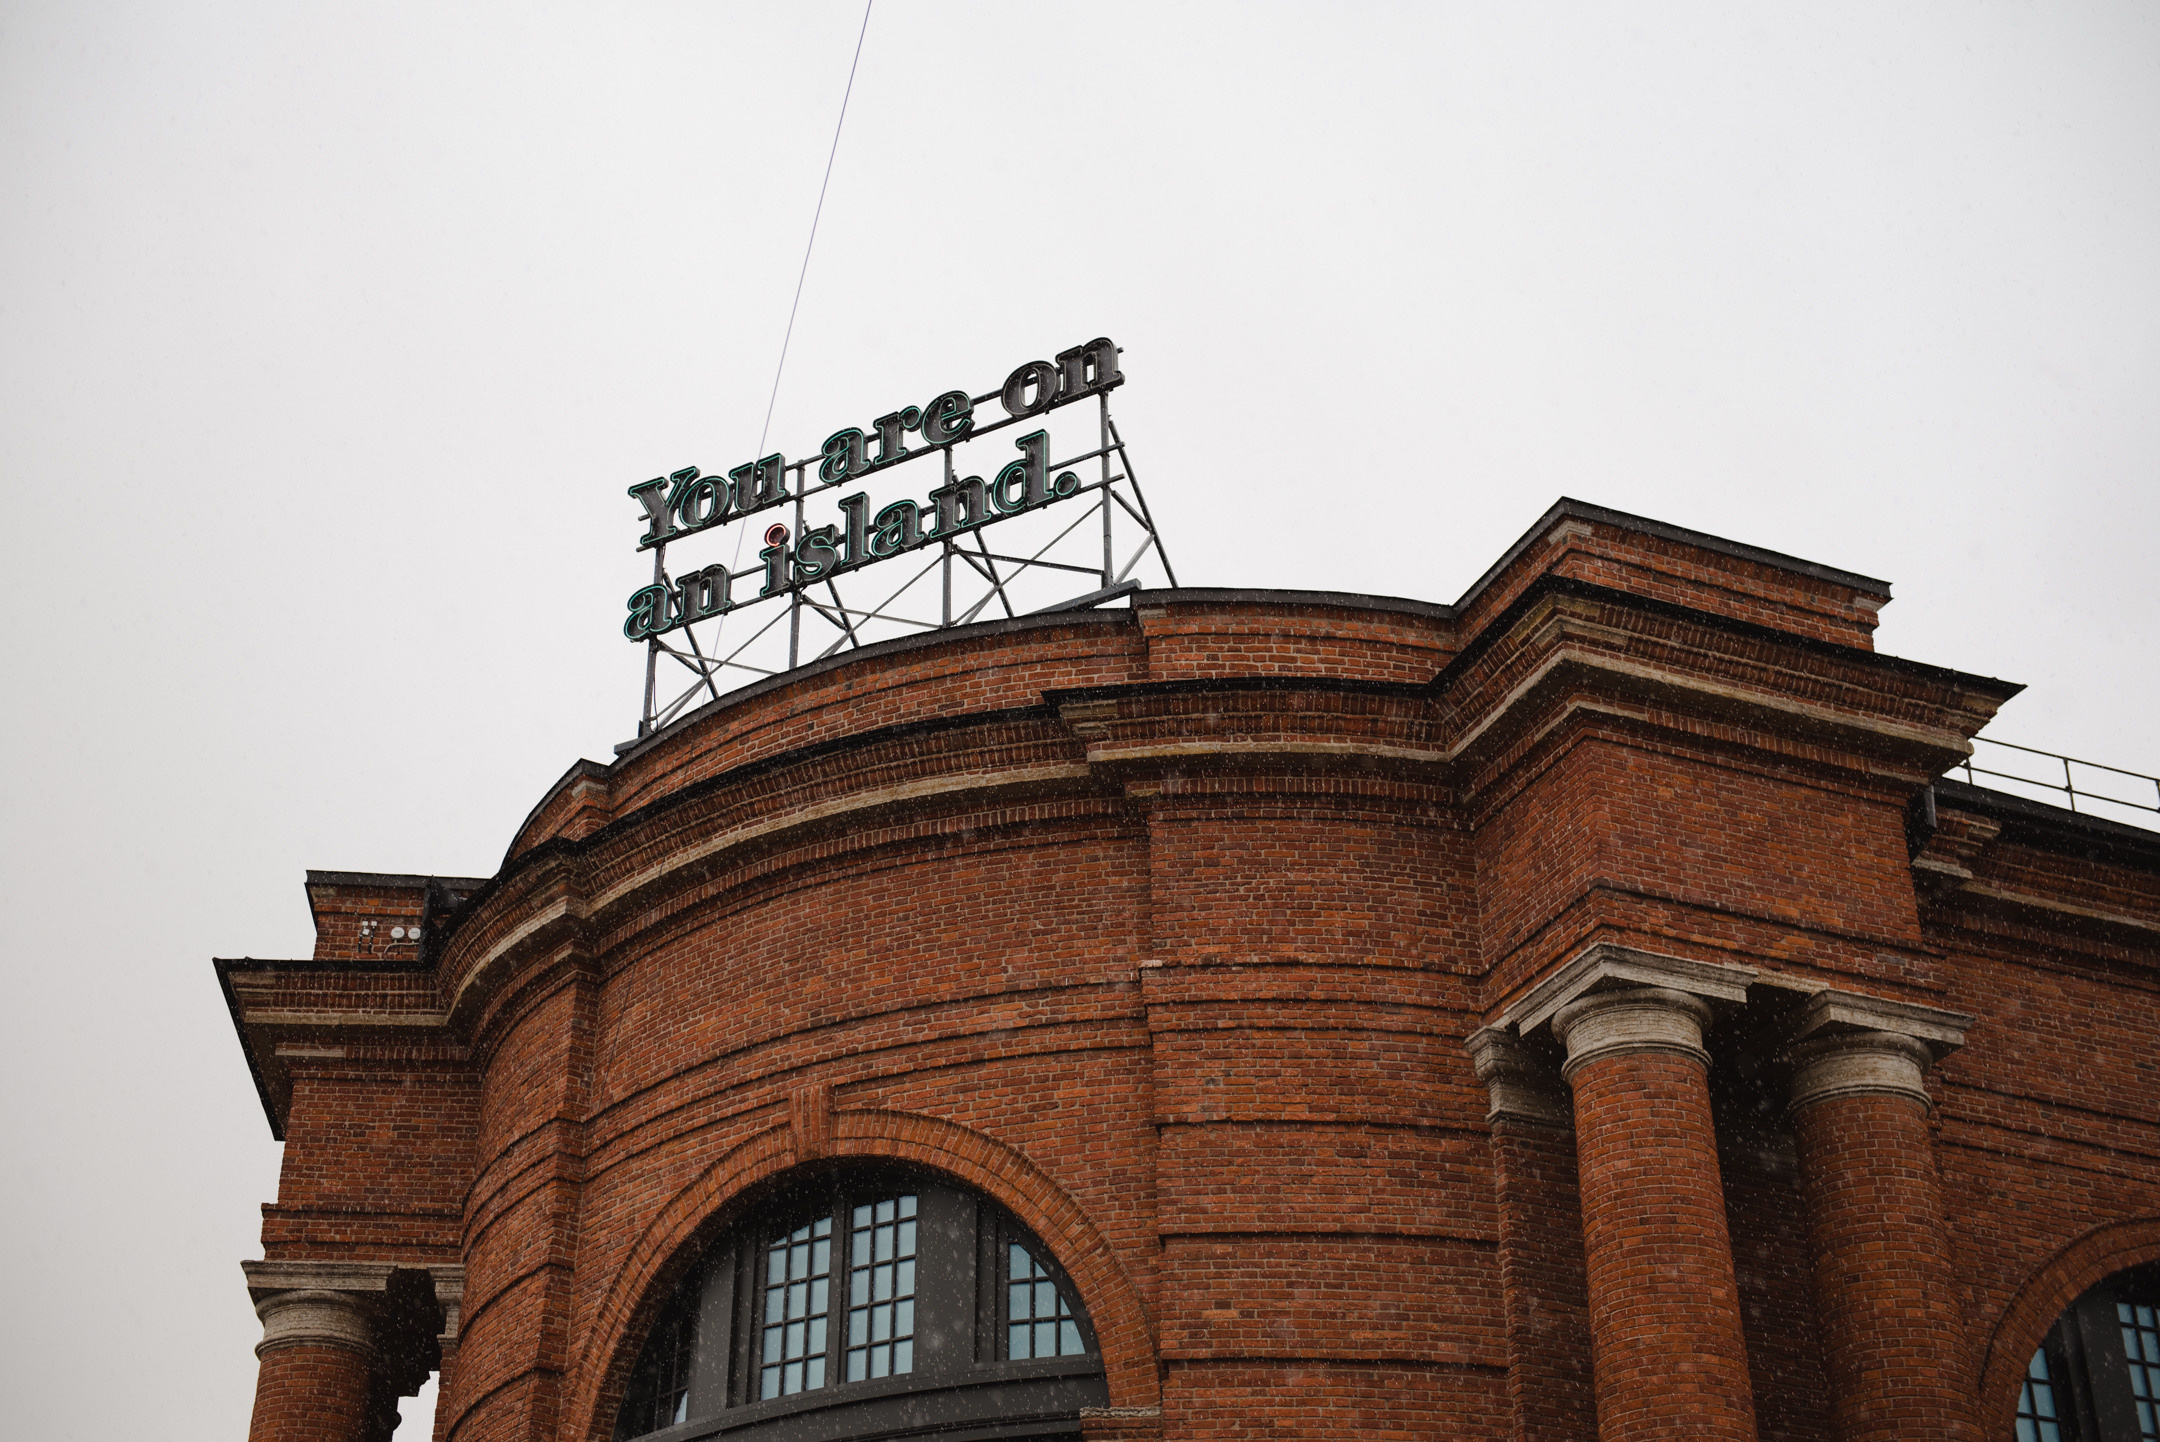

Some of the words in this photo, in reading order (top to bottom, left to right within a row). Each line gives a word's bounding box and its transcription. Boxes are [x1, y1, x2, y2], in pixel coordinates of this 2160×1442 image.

[624, 563, 732, 642] an
[760, 429, 1081, 598] island.
[628, 453, 789, 547] You
[820, 390, 974, 486] are
[1001, 337, 1125, 418] on
